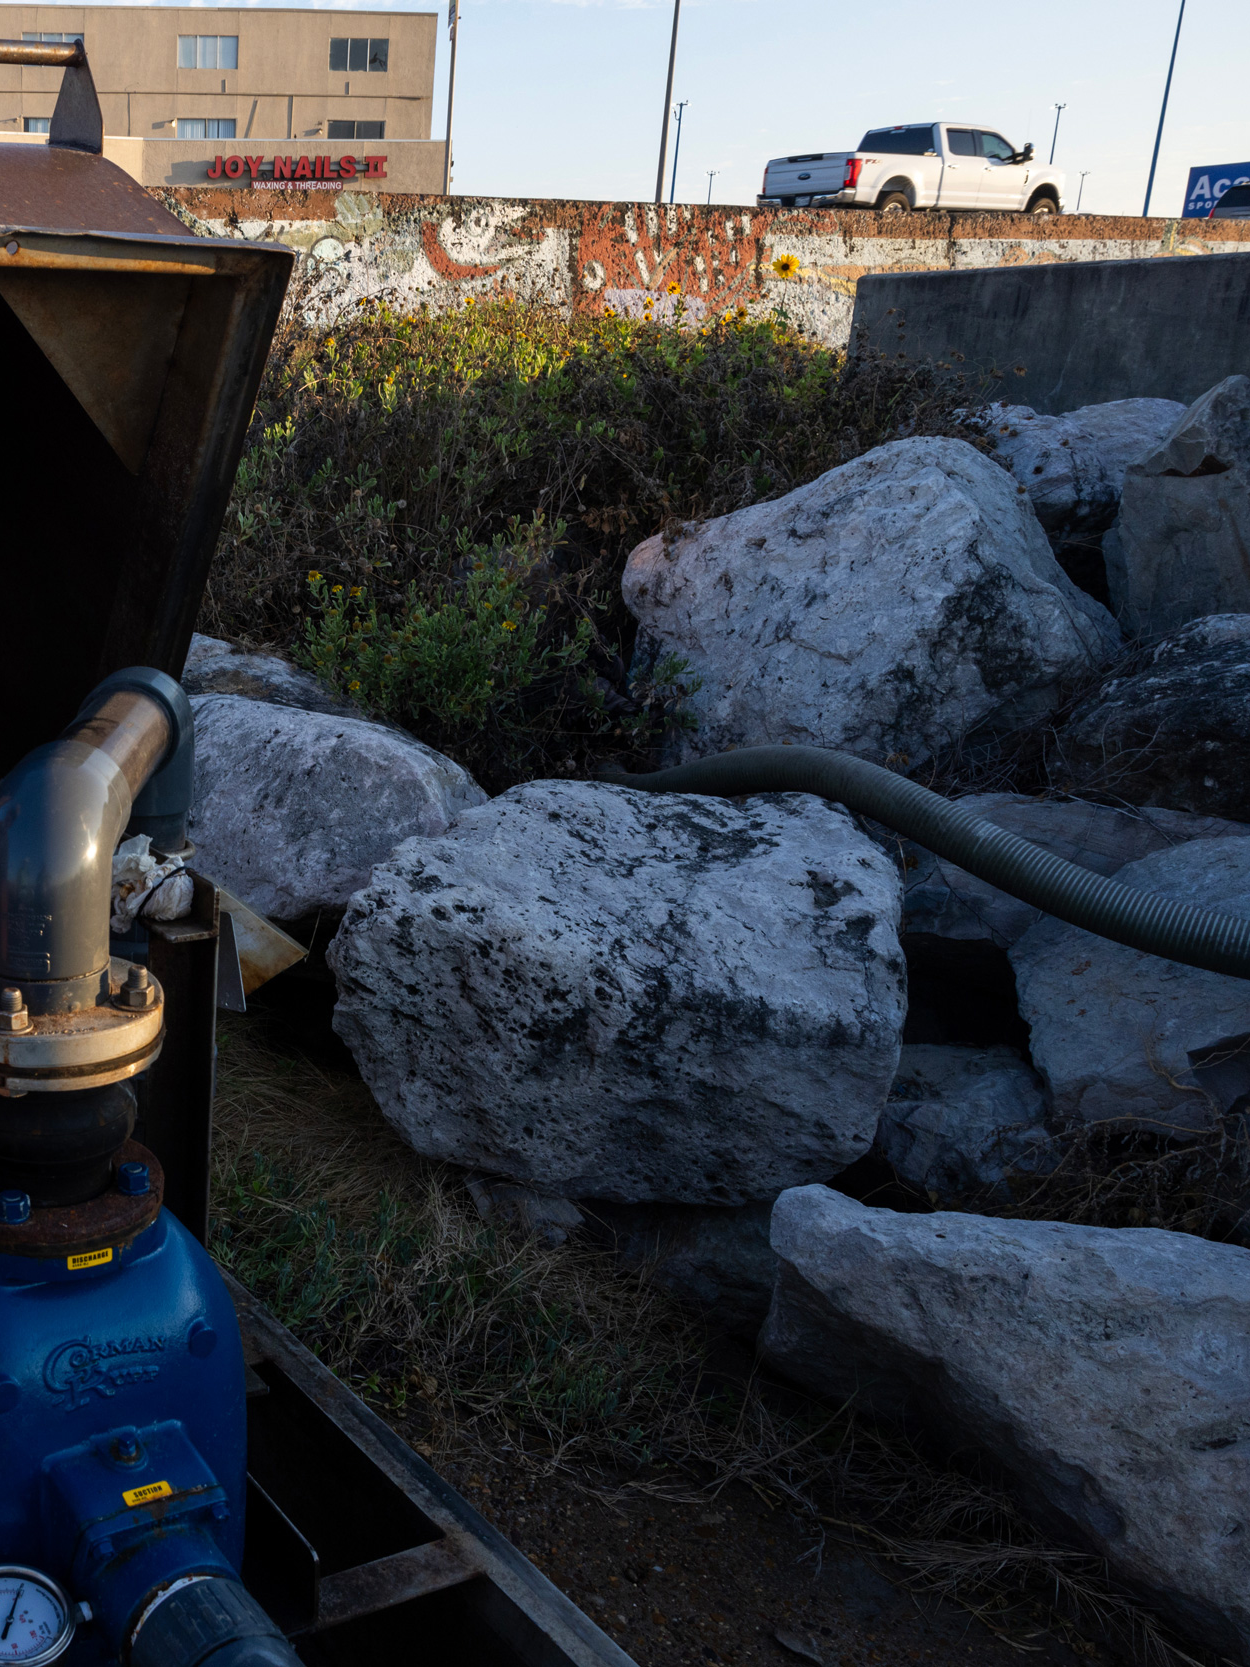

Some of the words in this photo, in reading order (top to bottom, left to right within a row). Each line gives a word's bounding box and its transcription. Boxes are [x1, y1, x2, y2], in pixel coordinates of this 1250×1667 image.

[207, 155, 264, 179] JOY
[273, 155, 357, 178] NAILS
[364, 155, 388, 178] II
[253, 181, 285, 190] WAXING
[287, 181, 293, 190] &
[295, 181, 342, 190] THREADING
[72, 1250, 109, 1264] DISCHARGE
[133, 1485, 163, 1498] SUCTION
